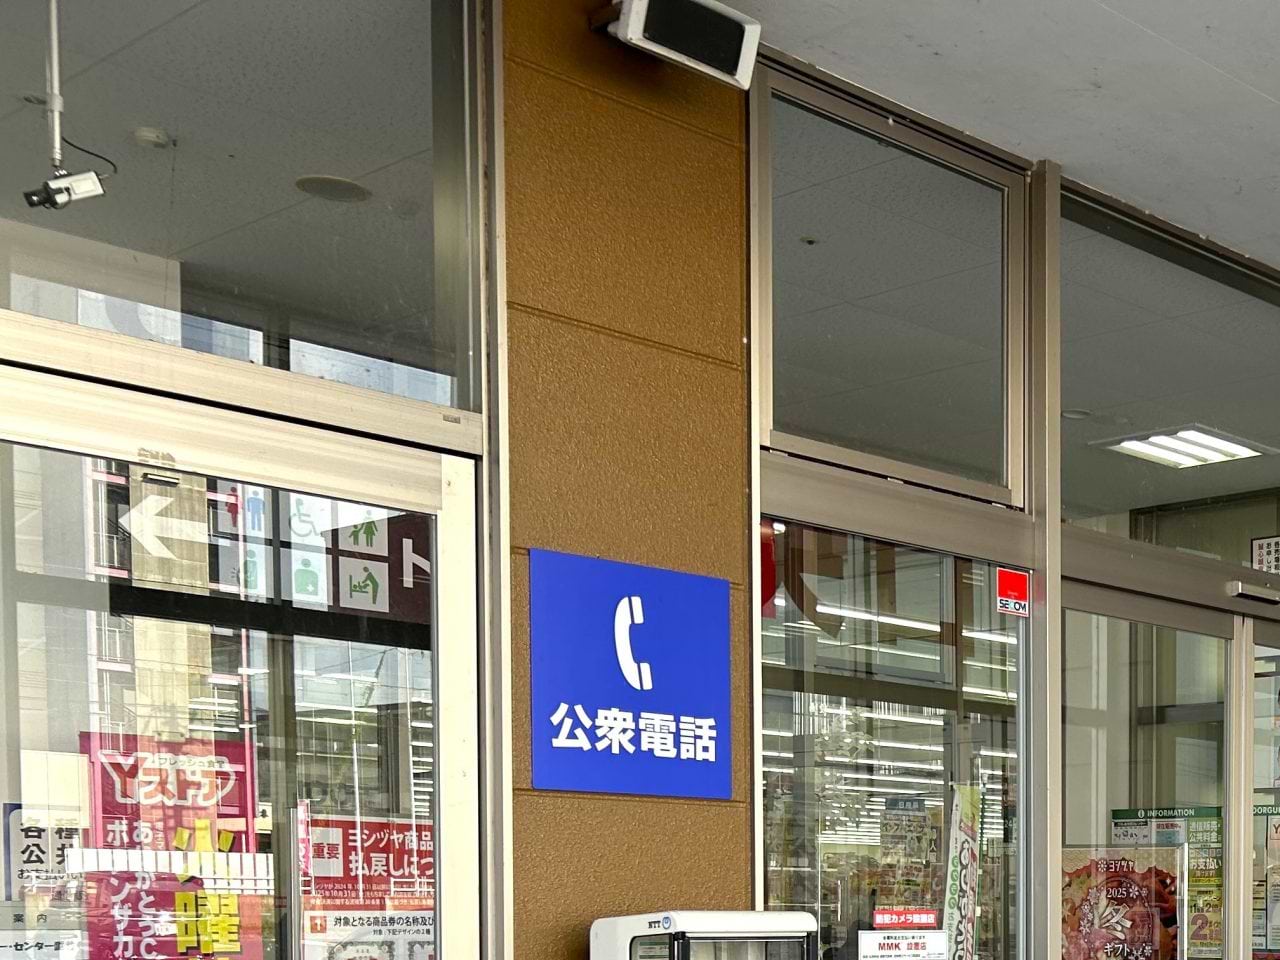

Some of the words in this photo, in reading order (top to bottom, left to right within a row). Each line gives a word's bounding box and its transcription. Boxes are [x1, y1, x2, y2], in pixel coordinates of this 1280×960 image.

[550, 702, 717, 762] 公衆電話
[1147, 809, 1195, 817] INFORMATION
[312, 842, 340, 860] 重要
[1106, 887, 1128, 898] 2025
[1100, 900, 1133, 941] 冬
[878, 943, 901, 951] MMK
[1103, 943, 1131, 958] ギフト
